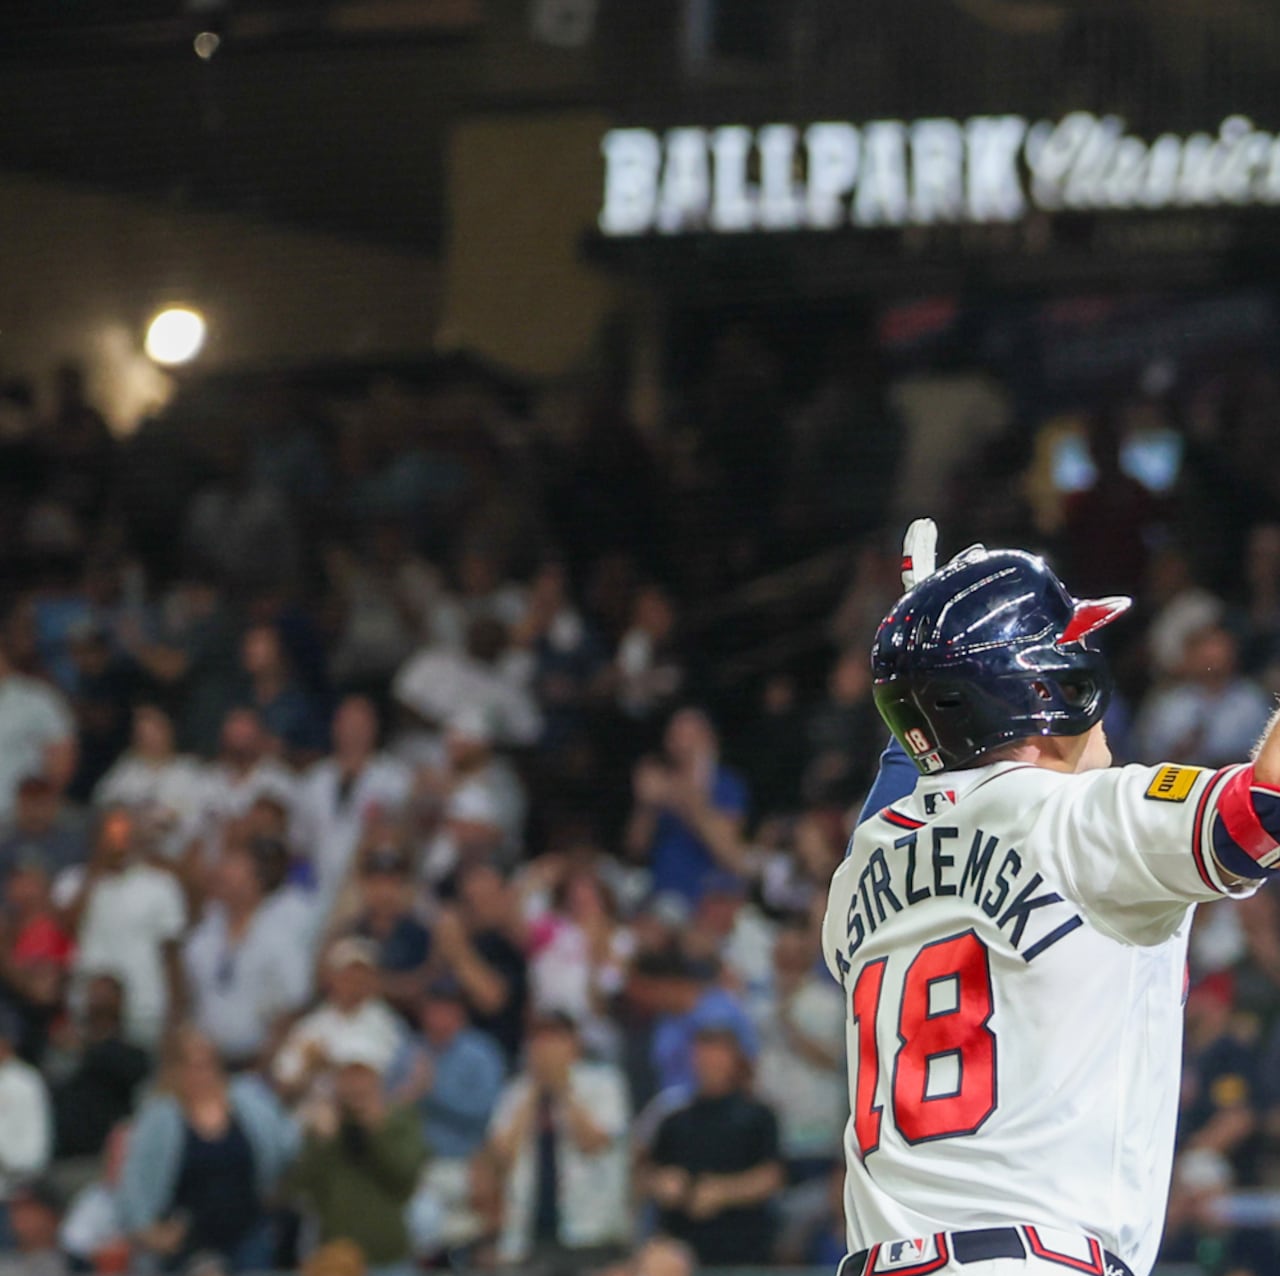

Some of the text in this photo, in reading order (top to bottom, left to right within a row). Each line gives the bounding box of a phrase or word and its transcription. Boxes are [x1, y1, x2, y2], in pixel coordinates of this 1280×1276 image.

[602, 114, 1027, 234] BALLPARK
[904, 727, 931, 755] 18
[852, 928, 998, 1159] 18
